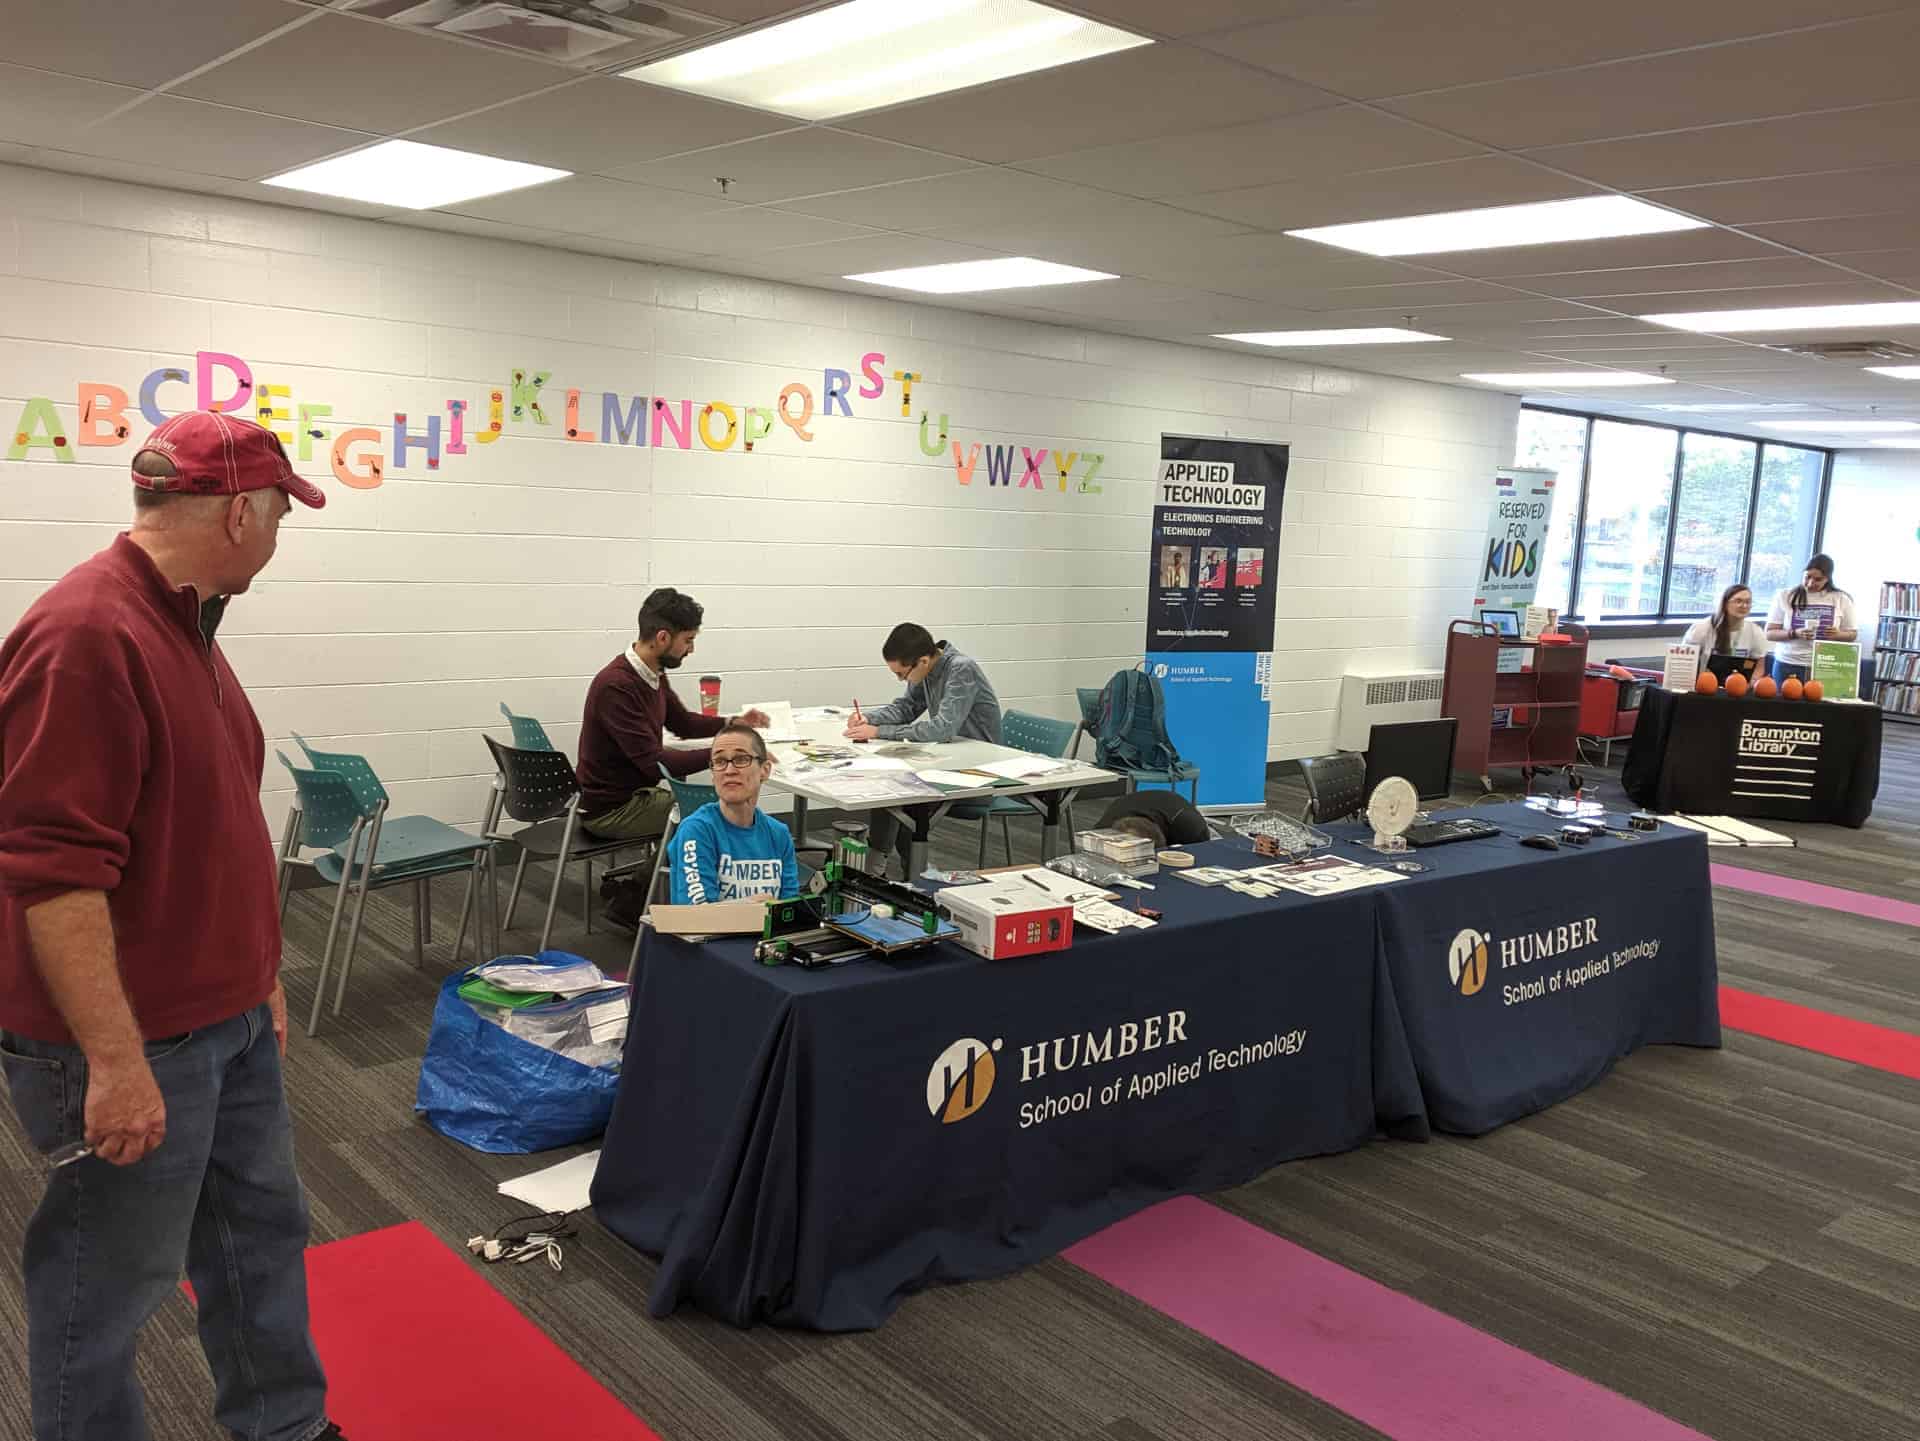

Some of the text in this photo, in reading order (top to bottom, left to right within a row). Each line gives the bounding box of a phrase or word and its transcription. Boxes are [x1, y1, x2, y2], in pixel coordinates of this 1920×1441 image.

[1164, 463, 1229, 483] APPLIED
[1163, 485, 1262, 506] TECHNOLOGY
[1163, 512, 1264, 525] ELECTRONICS ENGINEERING
[1499, 502, 1545, 520] RESERVED
[1162, 526, 1212, 537] TECHNOLOGY
[1507, 522, 1528, 539] FOR
[1484, 537, 1539, 581] KIDS
[1170, 666, 1205, 674] HUMBER
[1742, 723, 1820, 742] Brampton
[1739, 737, 1797, 756] Library
[720, 856, 782, 881] HMBER
[1501, 917, 1600, 968] HUMBER
[1503, 939, 1661, 1006] School of Applied Technology
[1019, 1010, 1188, 1082] HUMBER
[1018, 1028, 1308, 1128] School of Applied Technology
